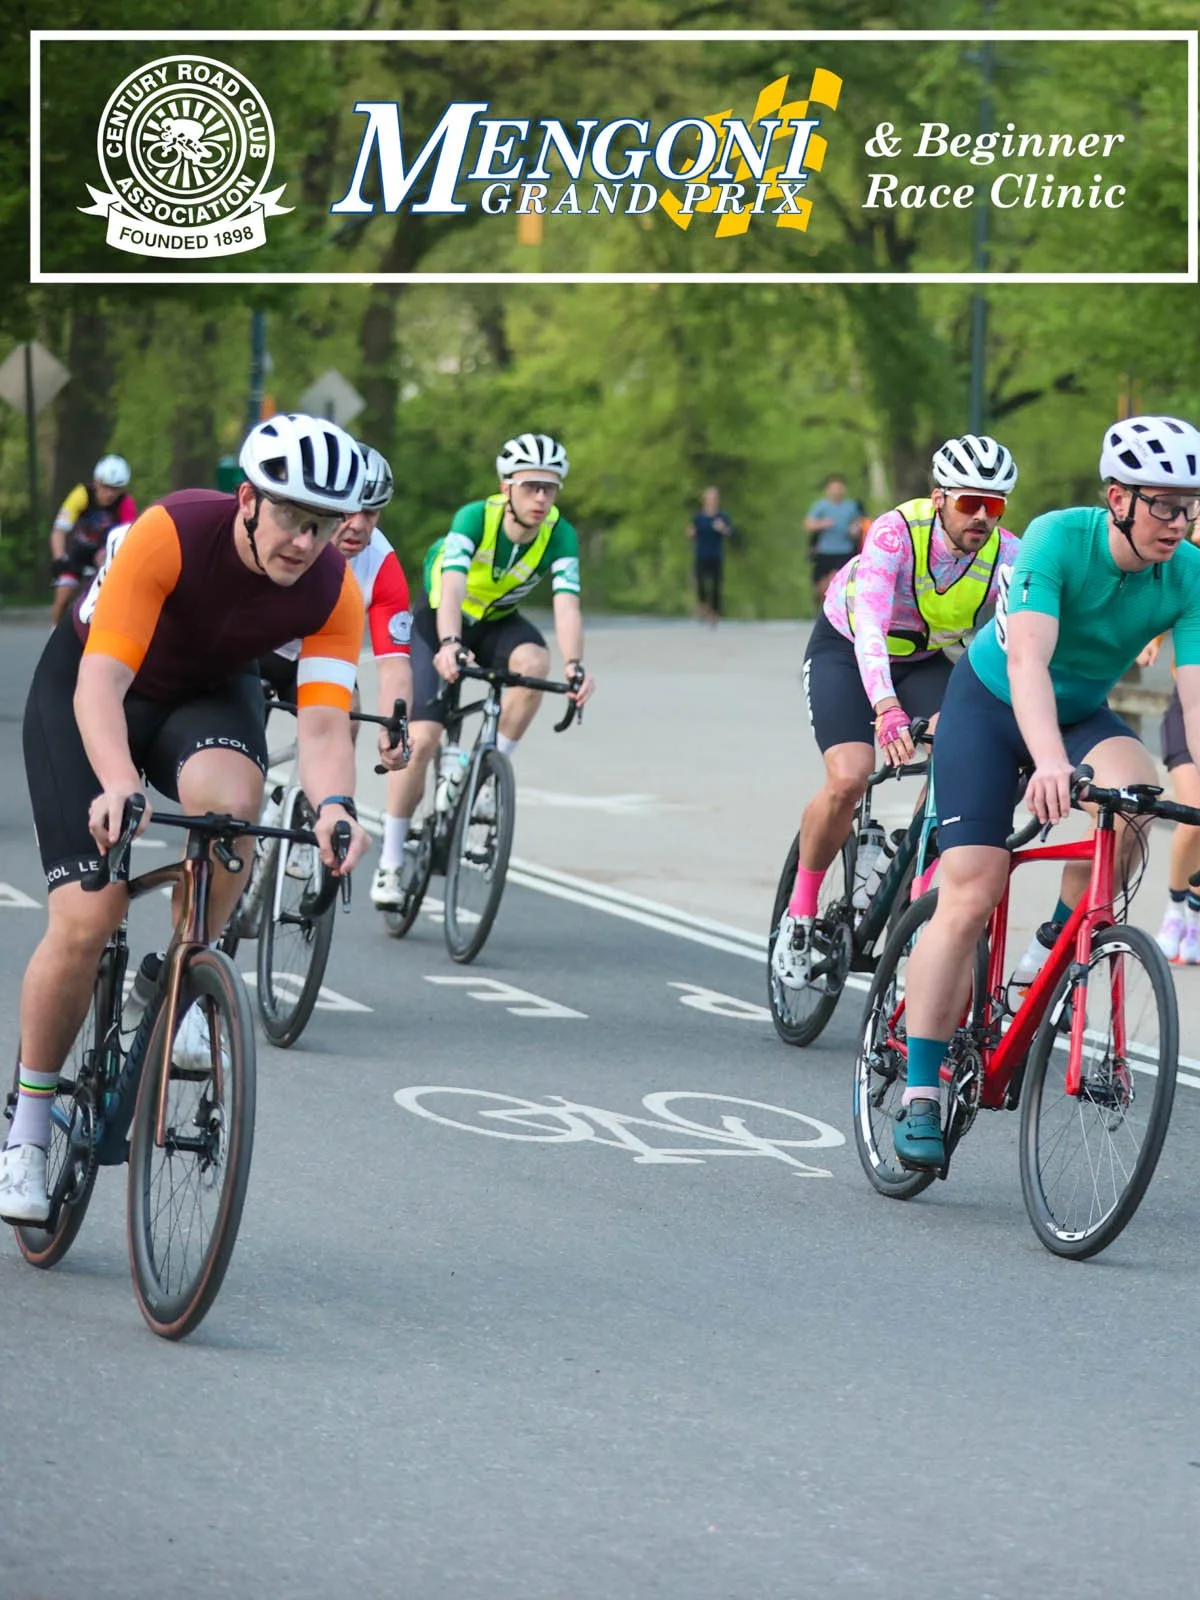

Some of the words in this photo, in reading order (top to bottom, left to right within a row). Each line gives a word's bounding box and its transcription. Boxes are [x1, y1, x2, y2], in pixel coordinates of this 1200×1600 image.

[196, 738, 214, 748] LE
[218, 737, 249, 753] COL
[78, 860, 99, 873] LE
